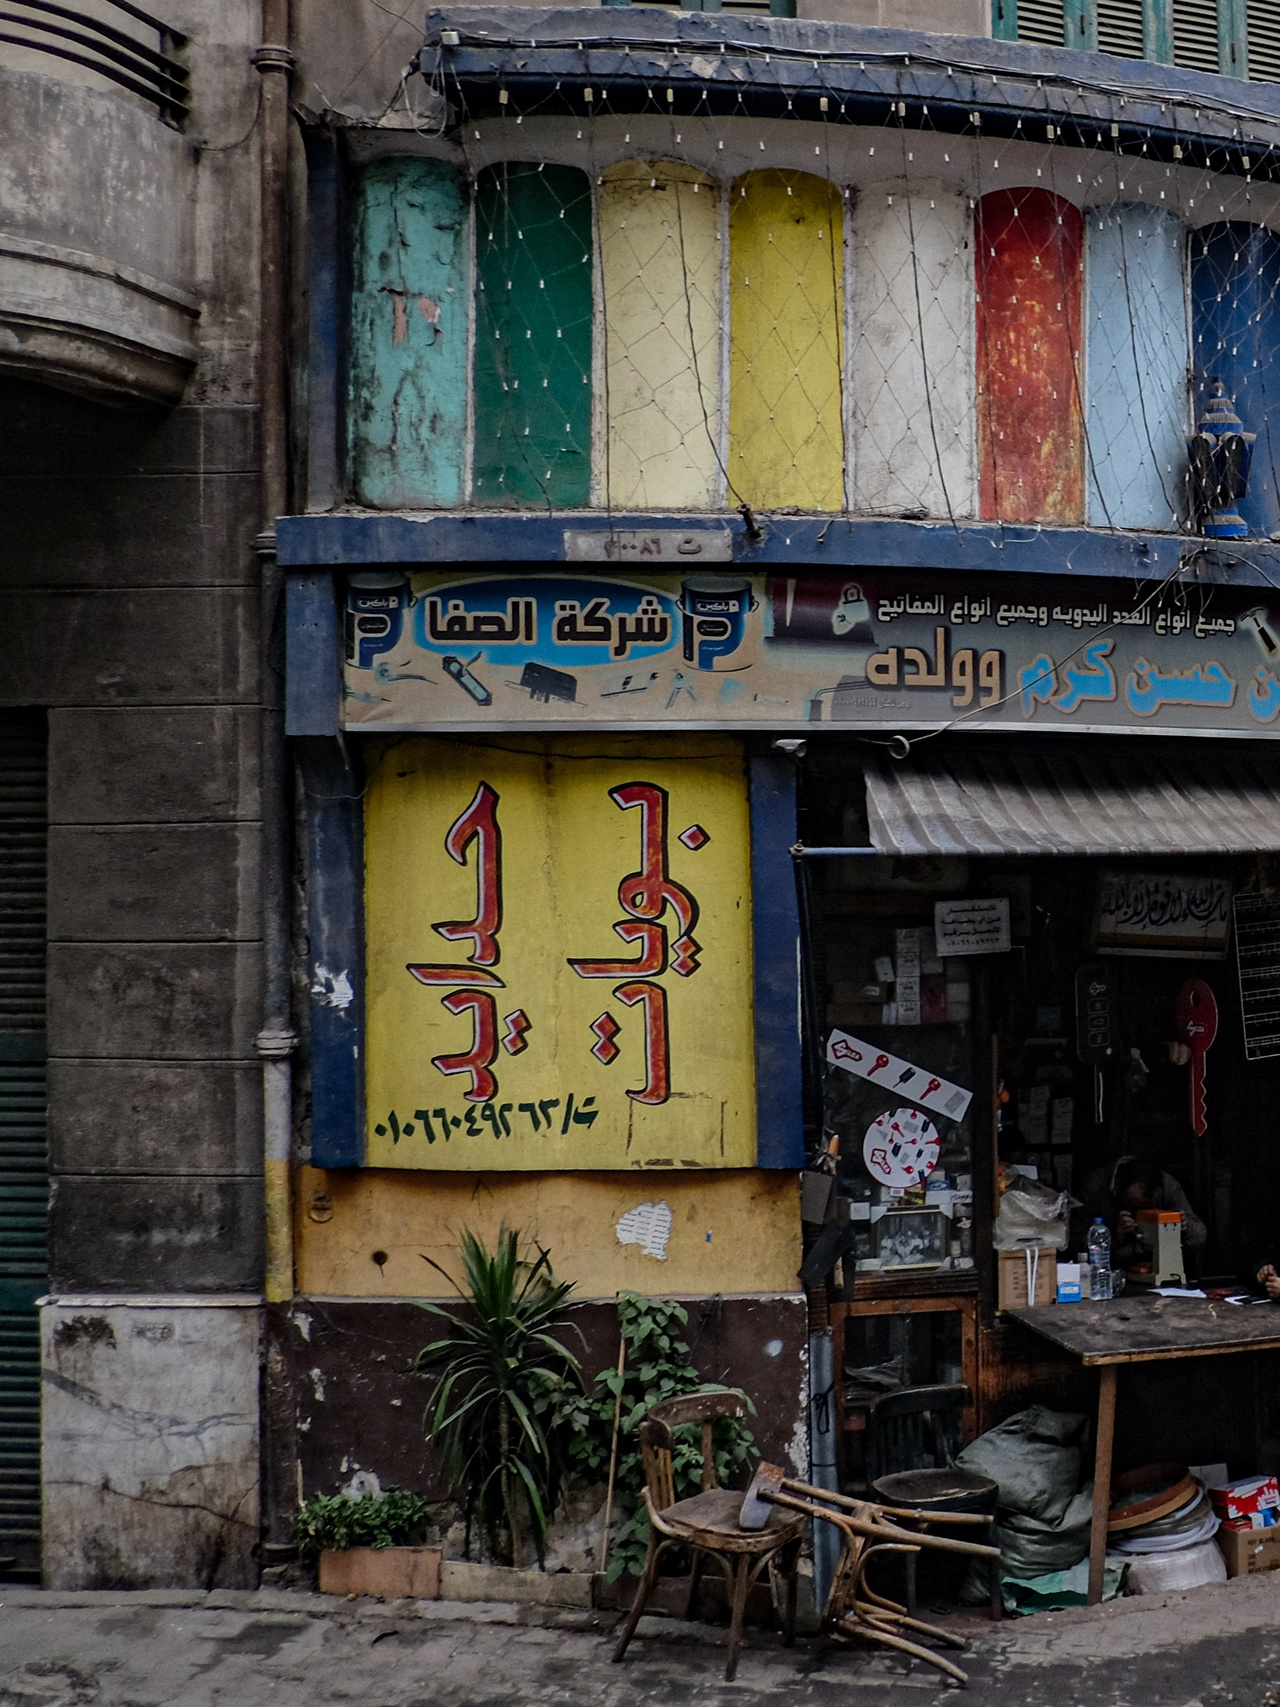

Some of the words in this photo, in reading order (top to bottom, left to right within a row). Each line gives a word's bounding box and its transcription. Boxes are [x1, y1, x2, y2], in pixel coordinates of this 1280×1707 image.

[425, 595, 537, 645] الصفا
[555, 594, 673, 658] شركة
[877, 593, 946, 622] المفاتيح
[996, 603, 1049, 627] وجميع
[1112, 605, 1152, 626] العدد
[1194, 613, 1237, 639] جميع
[866, 625, 1002, 708] وولده
[1016, 637, 1117, 720] كرم
[1125, 655, 1238, 718] حسن
